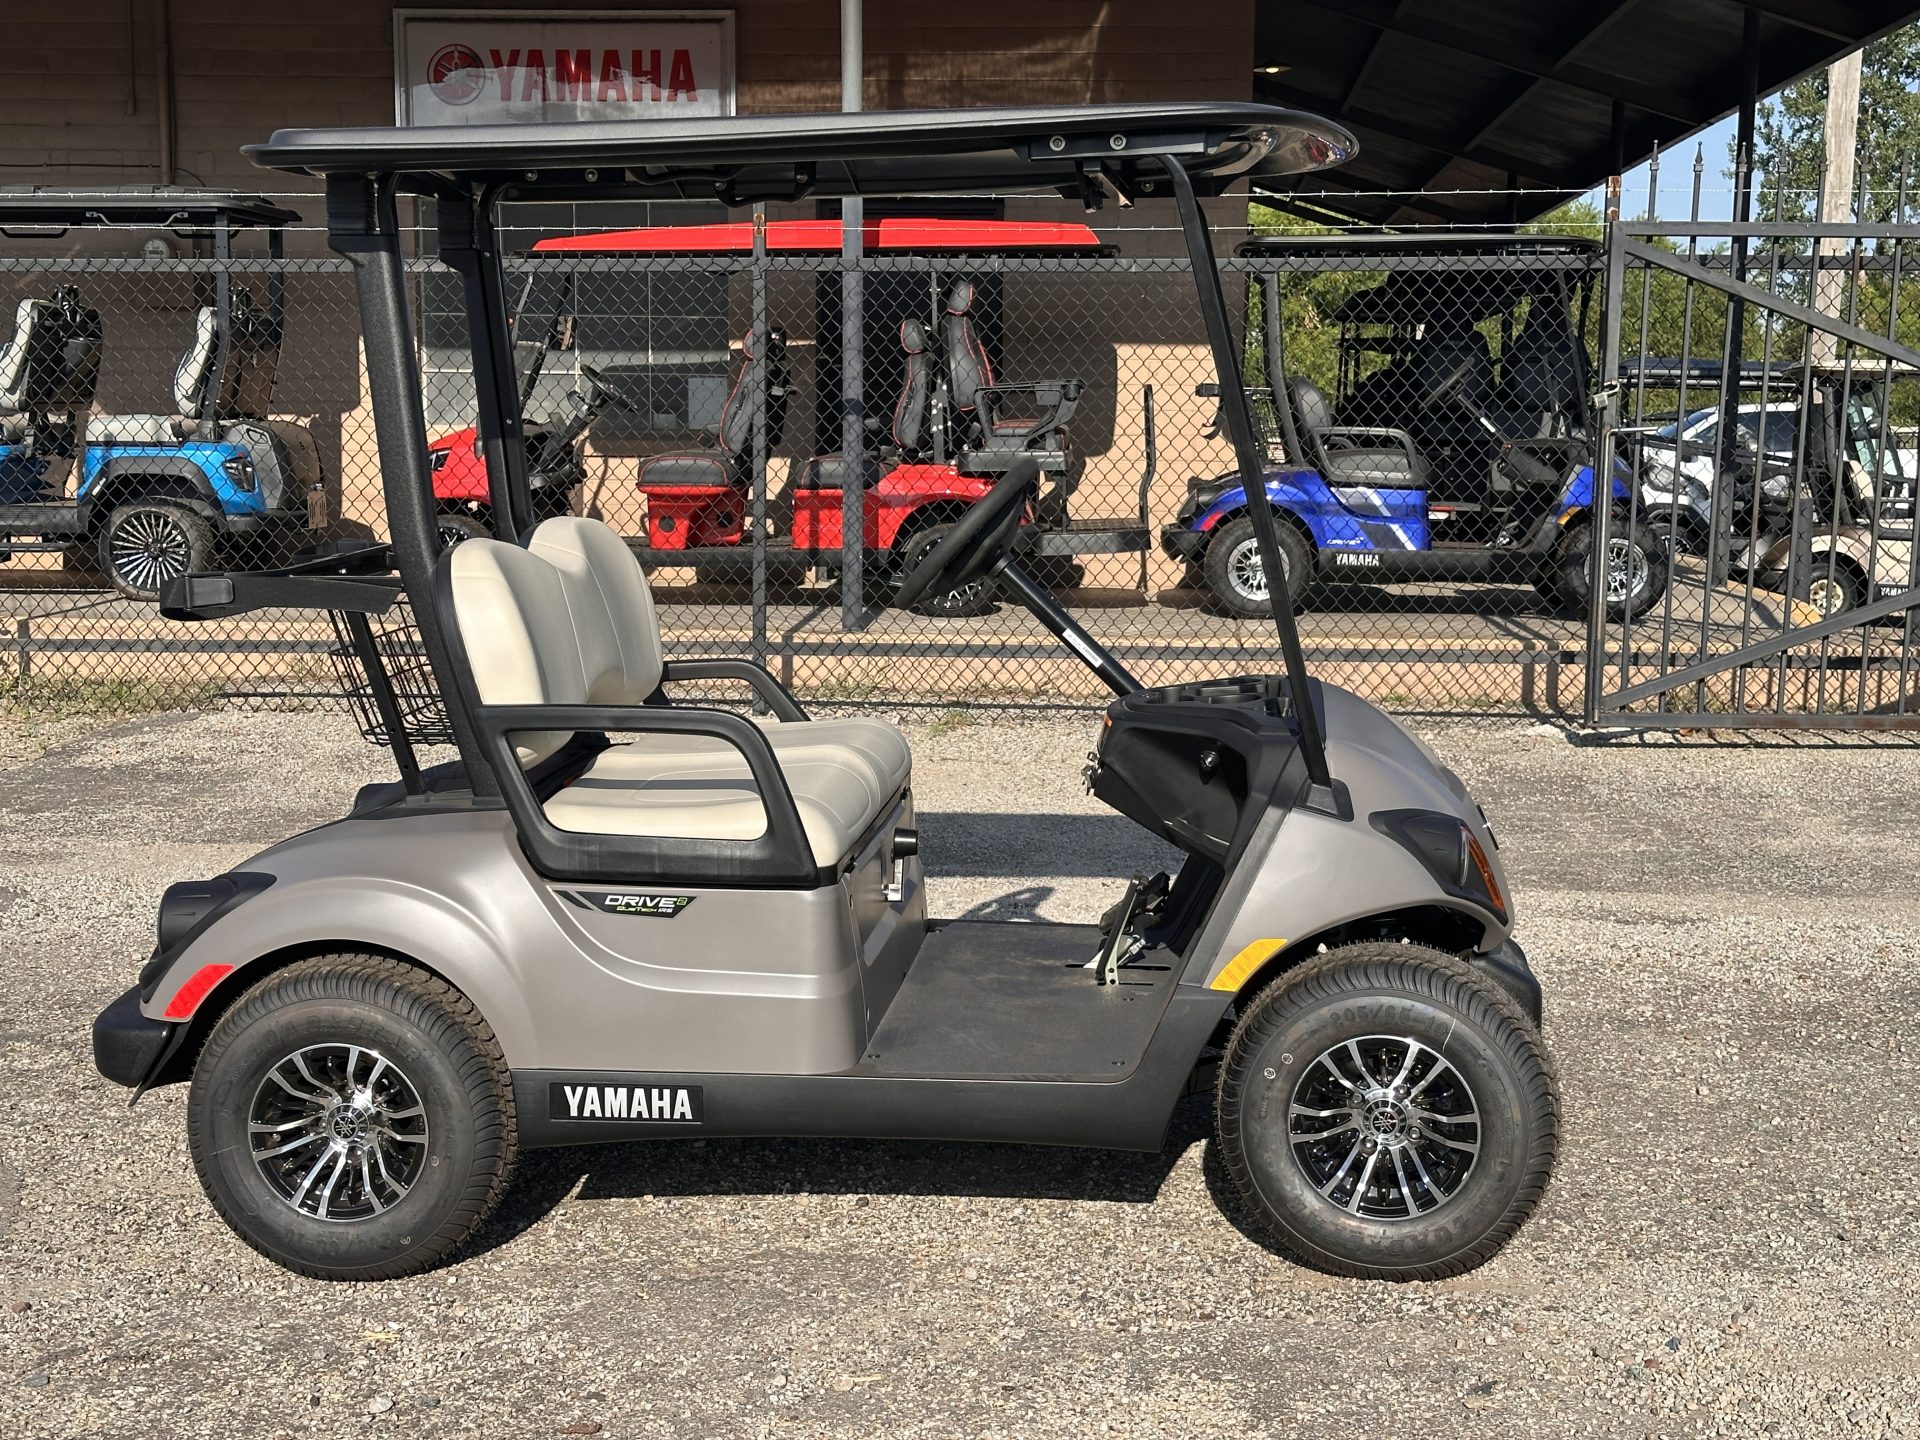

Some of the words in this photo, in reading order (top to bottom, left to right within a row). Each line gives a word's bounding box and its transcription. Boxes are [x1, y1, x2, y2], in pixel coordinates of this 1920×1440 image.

[489, 49, 699, 103] YAMAHA
[1335, 553, 1380, 567] YAMAHA
[1880, 587, 1909, 597] YAMA
[563, 1085, 693, 1120] YAMAHA
